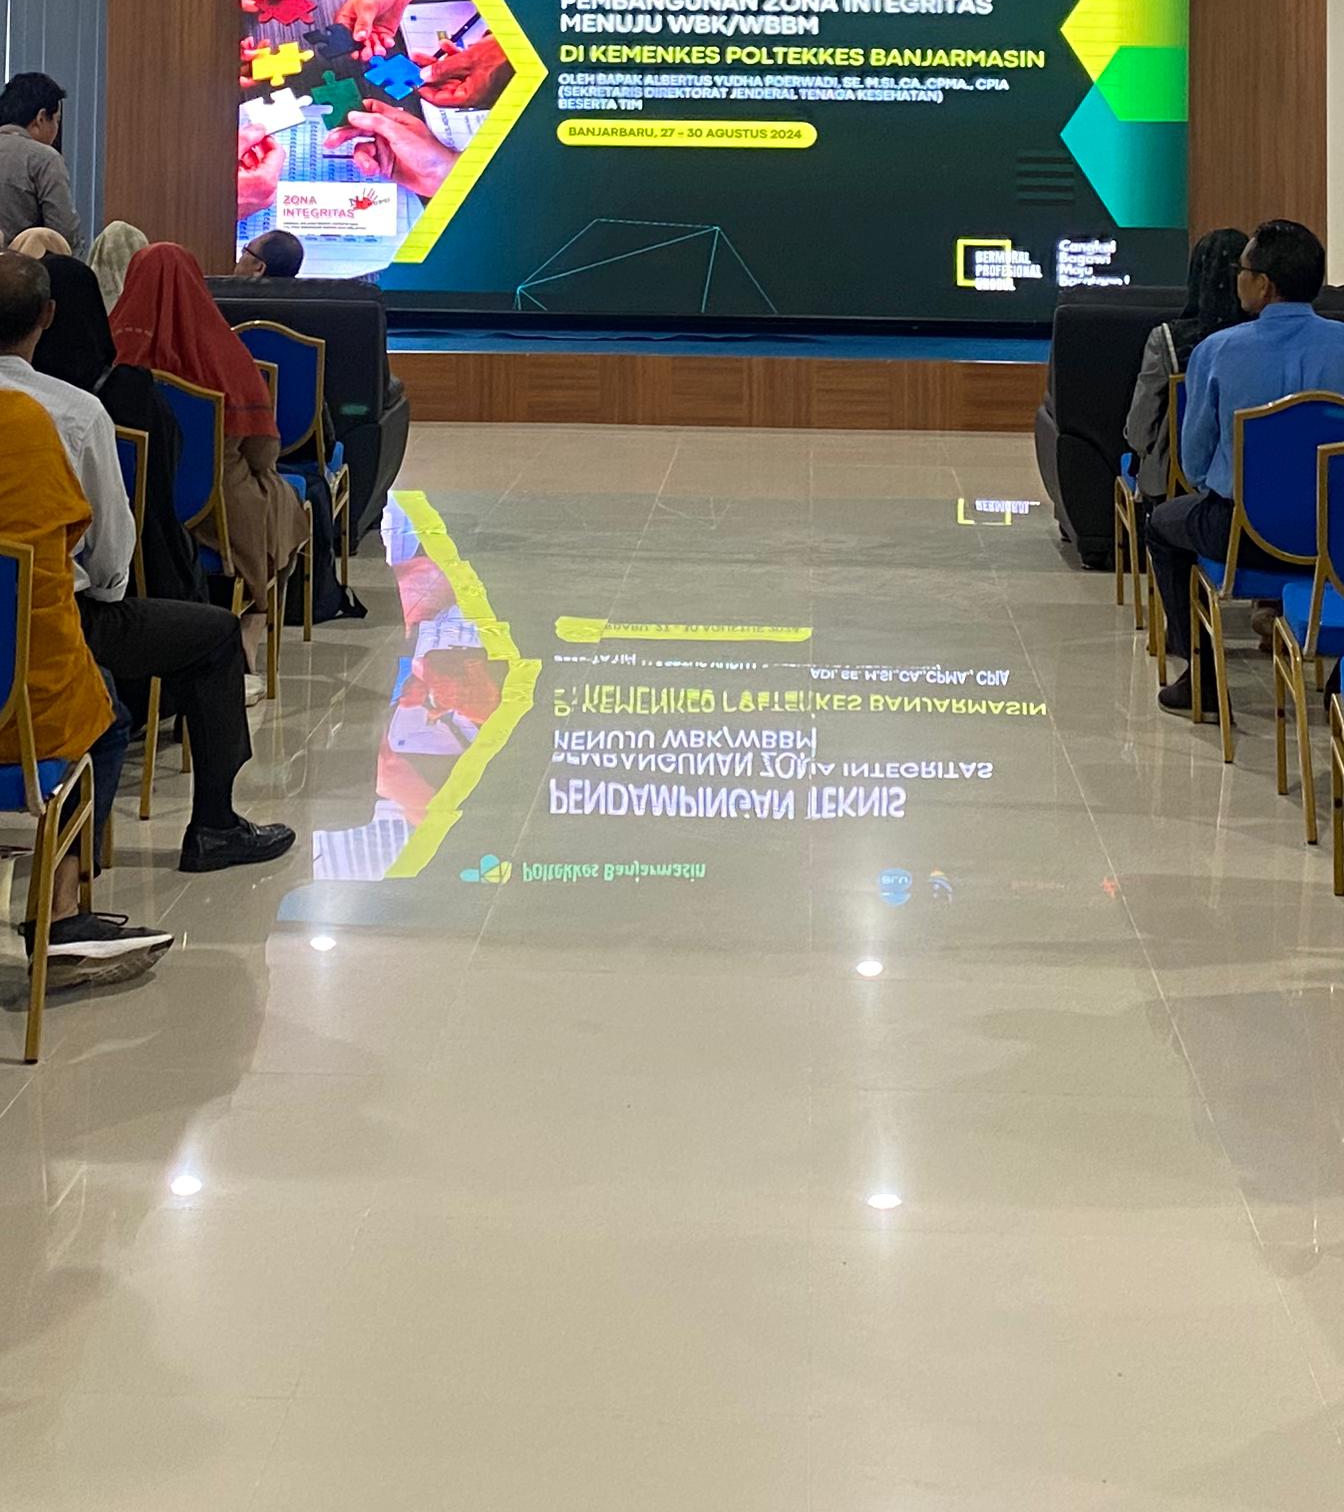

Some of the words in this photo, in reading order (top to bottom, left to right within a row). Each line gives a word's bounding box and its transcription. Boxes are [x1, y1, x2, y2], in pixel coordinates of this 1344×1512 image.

[560, 13, 663, 33] MENUJU
[666, 14, 820, 37] WBK/WBBM
[560, 45, 584, 63] DI
[589, 45, 721, 64] KEMENKES
[725, 46, 865, 66] POLTEKKES
[869, 48, 1045, 68] BANJARMASIN
[558, 73, 596, 86] OLEH
[597, 73, 643, 86] BAPAK
[644, 74, 713, 87] ALBERTUS
[714, 75, 763, 87] YUDHA
[764, 75, 841, 89] POERWADI,
[975, 78, 1010, 90] CPIA
[558, 86, 643, 99] (SEKRETARIS
[644, 87, 729, 99] DIREKTORAT
[730, 88, 798, 100] JENDERAL
[798, 88, 856, 100] TENAGA
[857, 89, 944, 104] KESEHATAN)
[558, 99, 618, 111] BESERTA
[619, 99, 644, 111] TIM
[568, 126, 658, 139] BANJARBARU,
[661, 128, 675, 138] 27
[687, 128, 703, 138] 30
[706, 128, 768, 139] AGUSTUS
[770, 129, 802, 139] 2024
[283, 195, 318, 205] ZONA
[283, 208, 354, 218] INTEGRITAS
